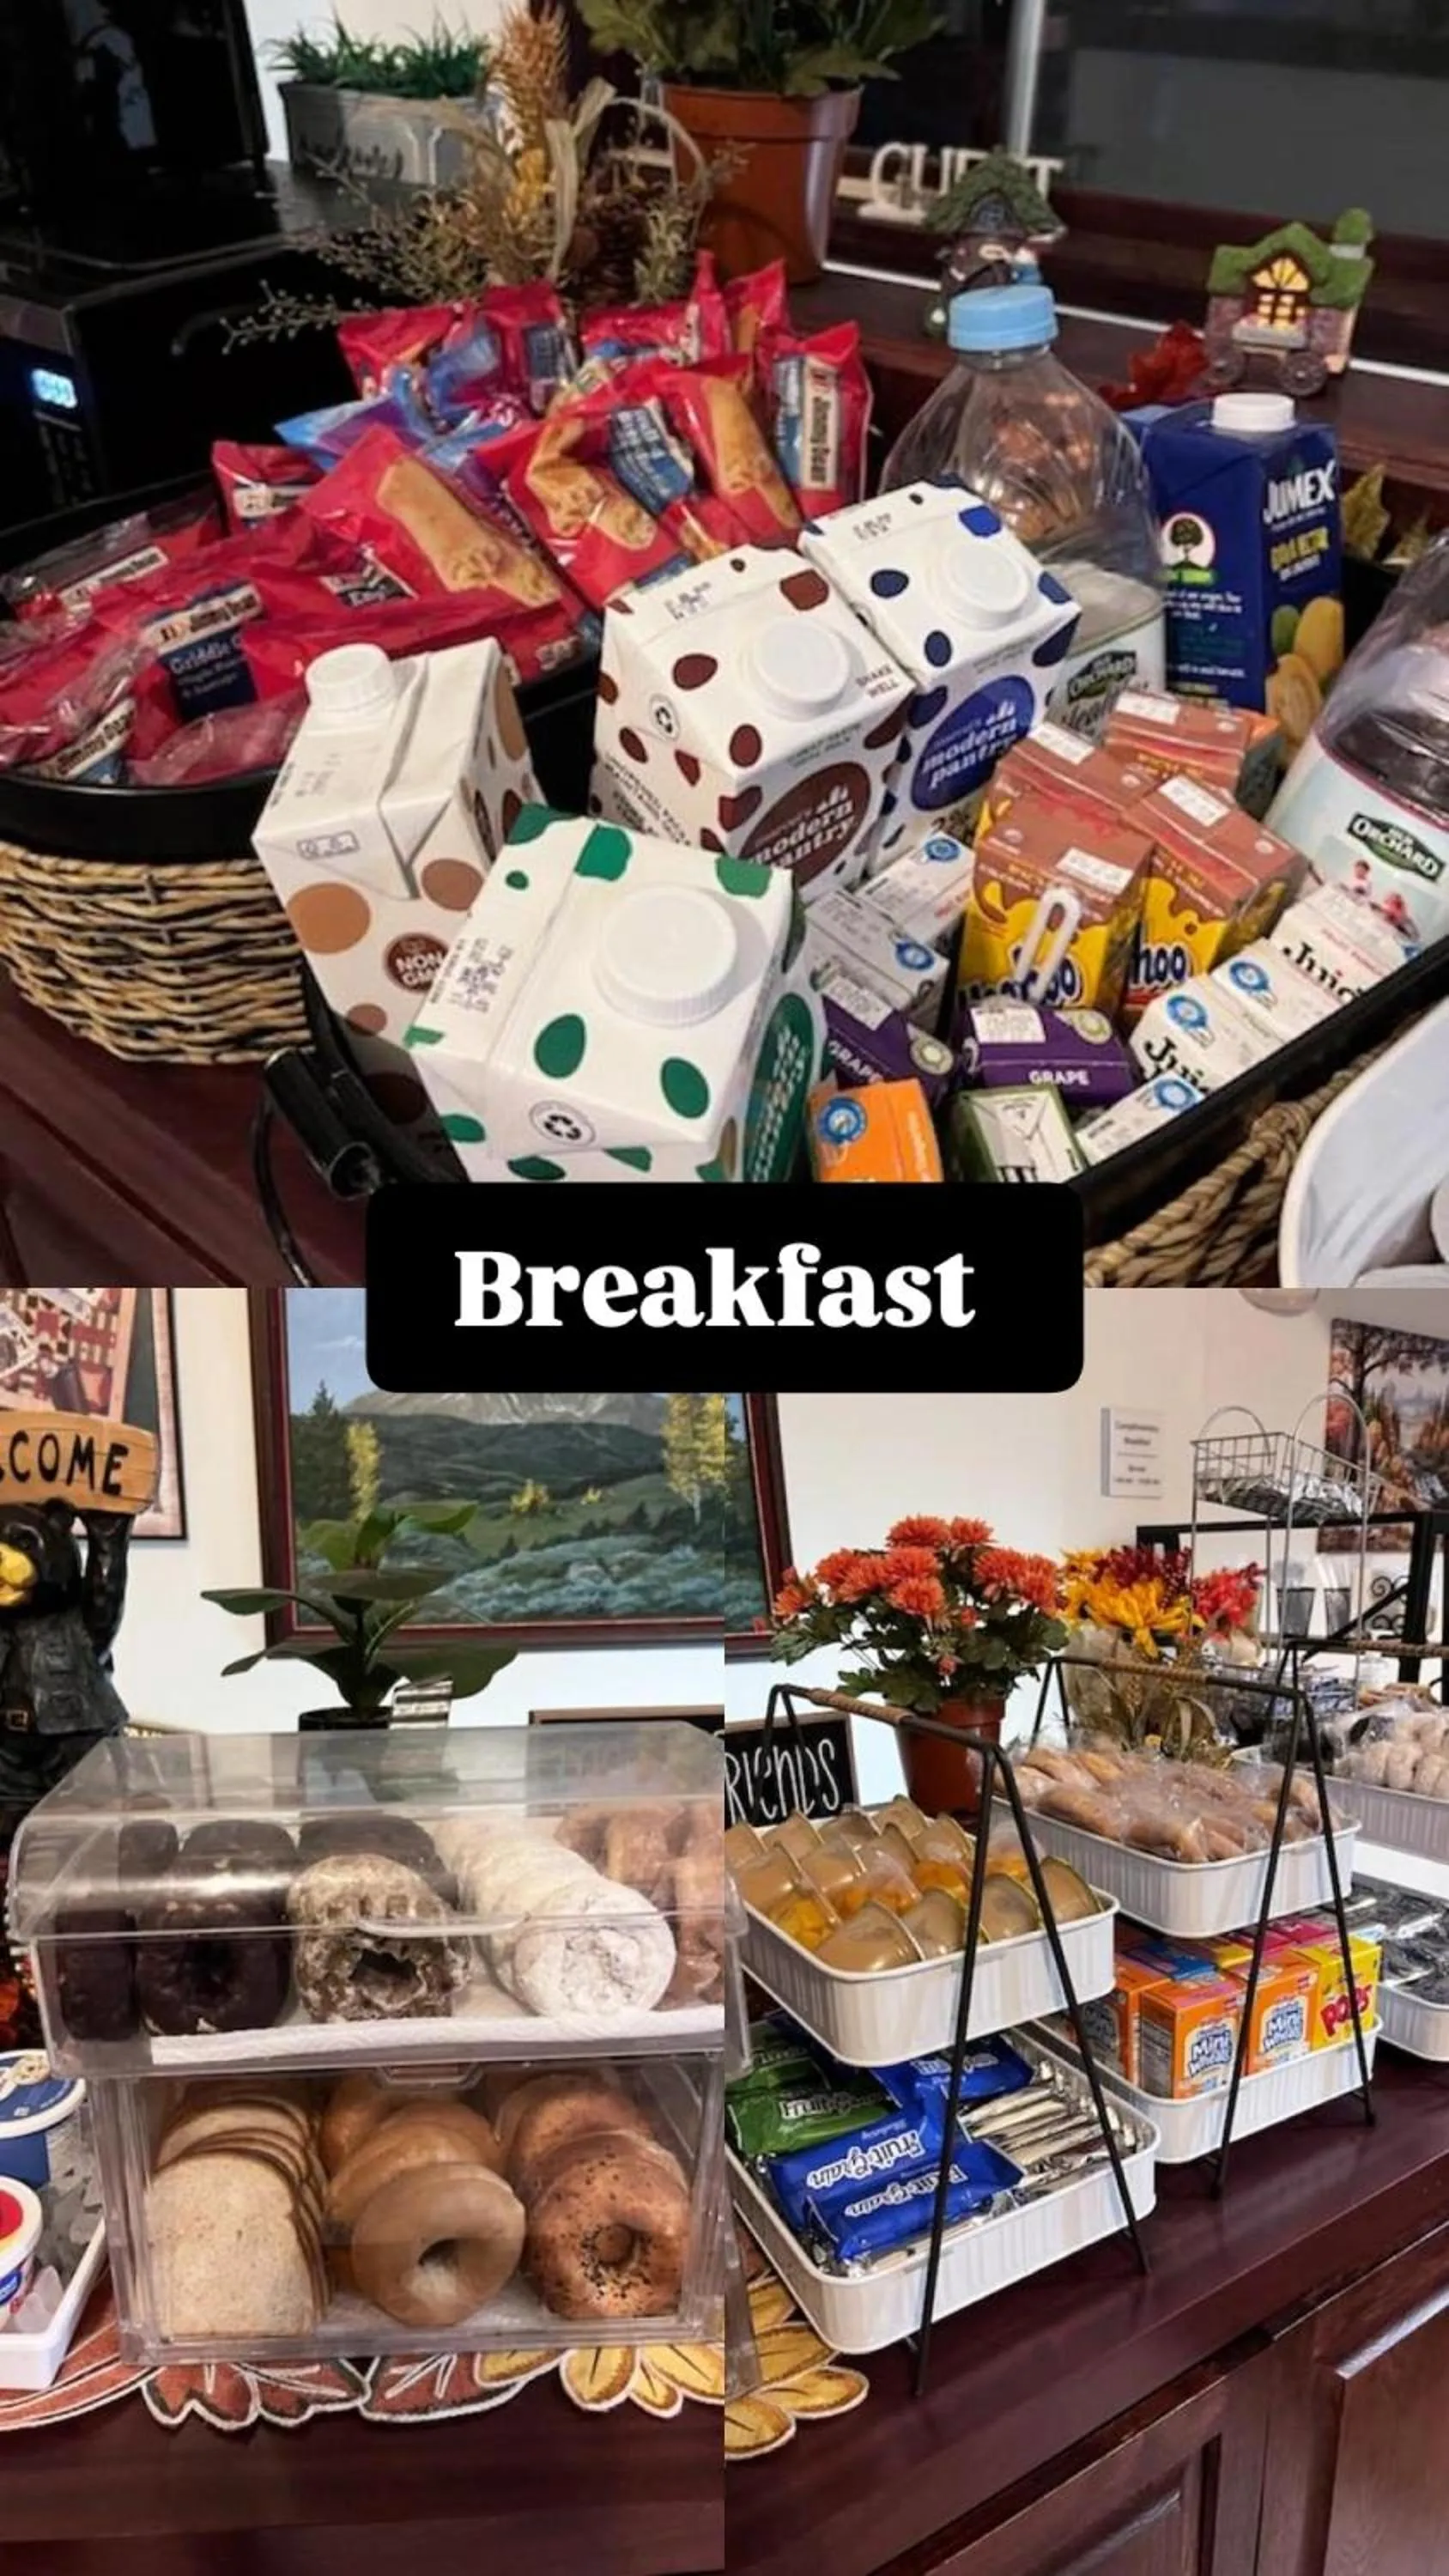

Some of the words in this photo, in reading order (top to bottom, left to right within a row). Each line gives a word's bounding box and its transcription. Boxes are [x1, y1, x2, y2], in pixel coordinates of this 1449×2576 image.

[1263, 460, 1336, 524] JUMEX
[770, 816, 857, 867] antry
[1351, 817, 1439, 877] ORCHARD
[827, 1038, 884, 1083] GRAP
[1028, 1070, 1090, 1087] GRAPE
[0, 1430, 130, 1496] COME
